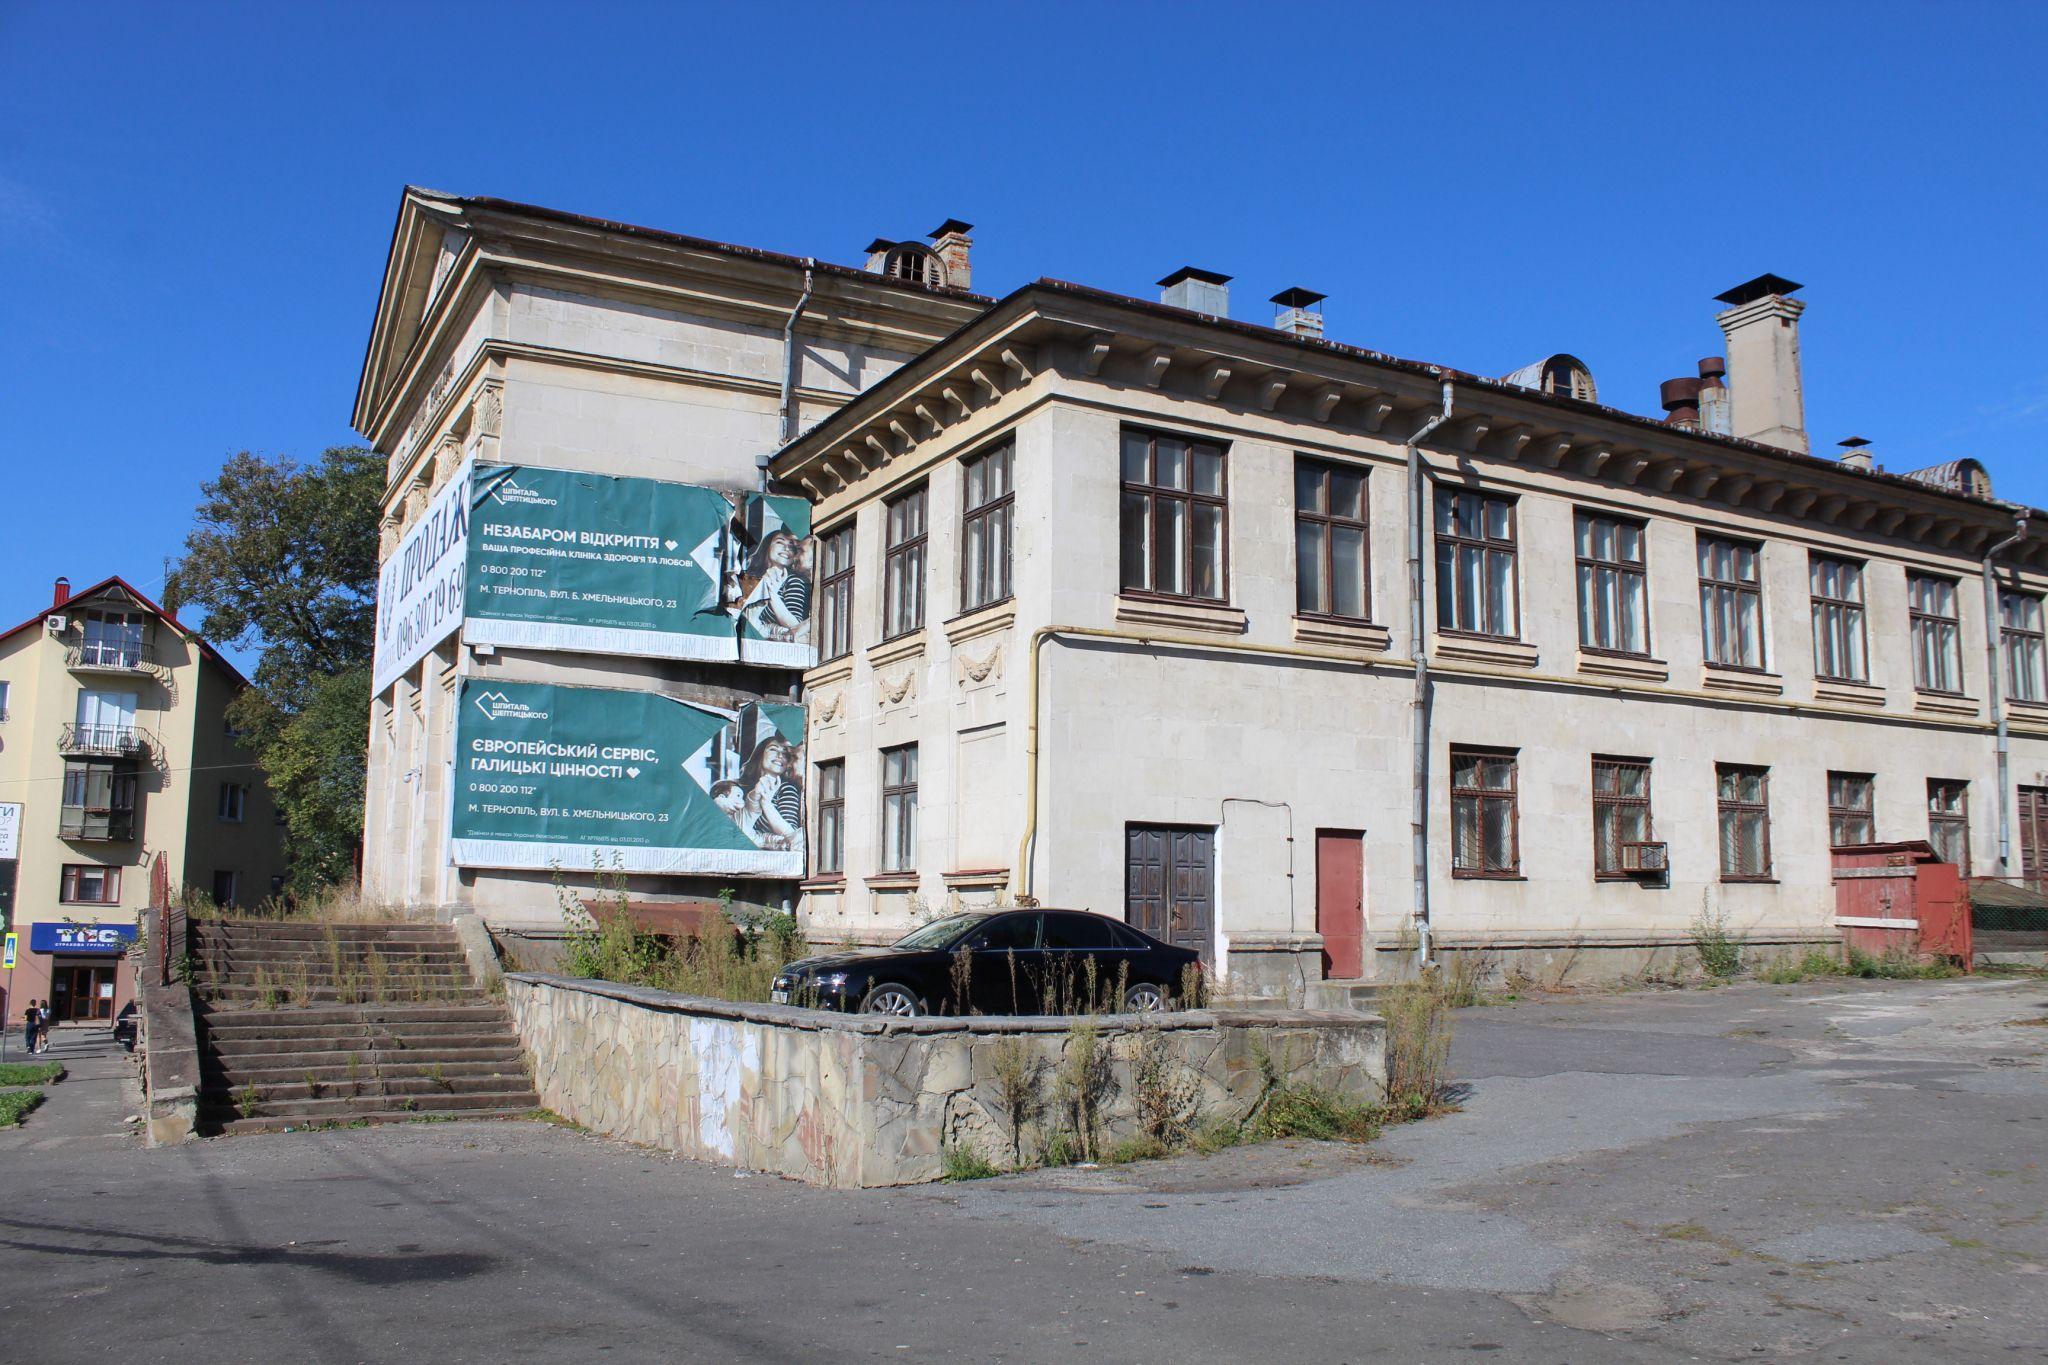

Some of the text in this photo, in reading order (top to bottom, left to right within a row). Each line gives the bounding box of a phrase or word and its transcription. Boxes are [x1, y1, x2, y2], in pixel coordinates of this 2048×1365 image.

[502, 487, 539, 498] ШПИТАЛЬ
[502, 494, 557, 506] ШЕПТИЦЬКОГО
[400, 473, 471, 603] ПРОДАЖ
[483, 523, 660, 549] НЕЗАБАРОМ ВІДКРИТТЯ
[482, 543, 693, 568] ВАША ПРОФЕСІЙНА КЛІНІКА ЗДОРОВ'Я ТА ЛЮБОВІ
[481, 565, 488, 574] 0
[489, 565, 508, 576] 800
[510, 567, 528, 577] 200
[480, 584, 677, 609] М. ТЕРНОПІЛЬ, ВУЛ. Б. ХМЕЛЬНИЦЬКОГО, 23
[397, 611, 413, 660] 096
[434, 578, 446, 626] 19
[449, 561, 465, 615] 69
[492, 701, 529, 711] ШПИТАЛЬ
[492, 708, 548, 719] ШЕПТИЦЬКОГО
[472, 738, 659, 764] ЄВРОПЕЙСЬКИЙ СЕРВІС,
[471, 757, 622, 779] ГАЛИЦЬКІ ЦІННОСТІ
[470, 783, 476, 791] 0
[479, 783, 498, 793] 800
[499, 784, 518, 794] 200
[468, 803, 669, 824] М. ТЕРНОПІЛЬ, ВУЛ. Б. ХМЕЛЬНИЦЬКОГО, 23
